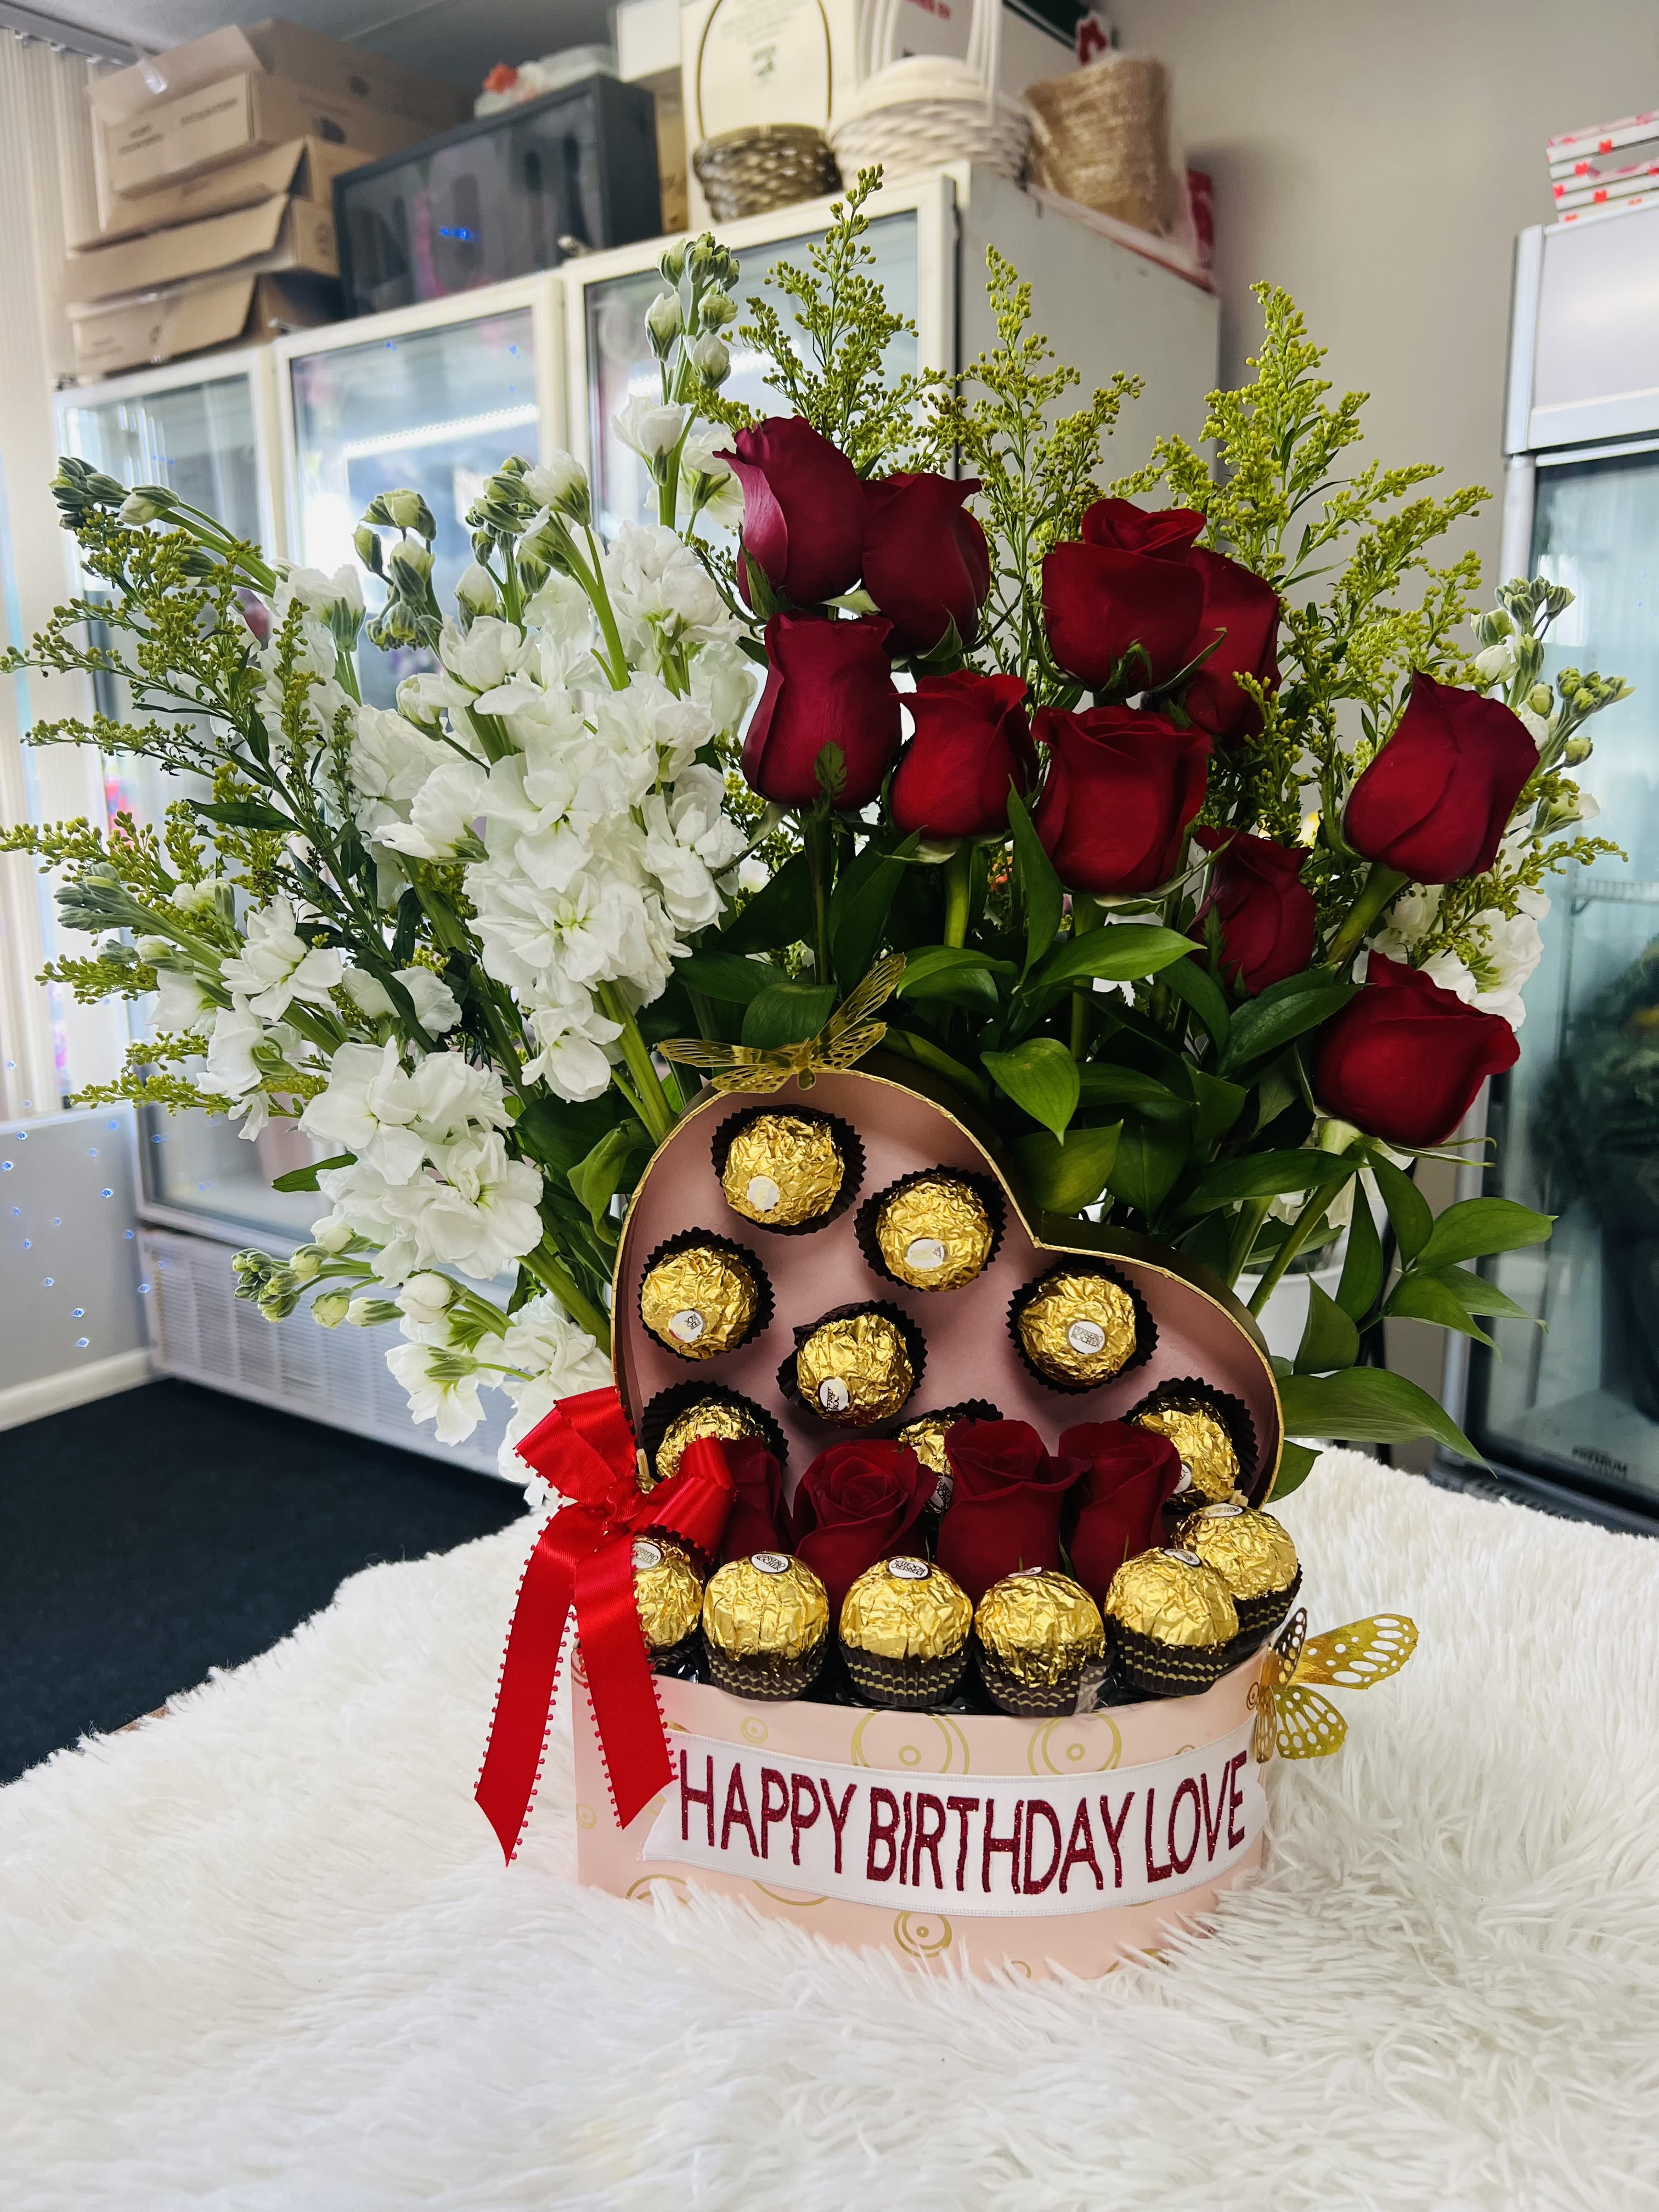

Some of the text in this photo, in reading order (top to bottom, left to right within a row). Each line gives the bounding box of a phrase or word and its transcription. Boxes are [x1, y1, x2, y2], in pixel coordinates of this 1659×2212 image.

[1071, 1333, 1101, 1348] ROCHER
[1073, 1325, 1103, 1342] FERRERO
[679, 1748, 1247, 1895] HAPPY BIRTHDAY LOVE
